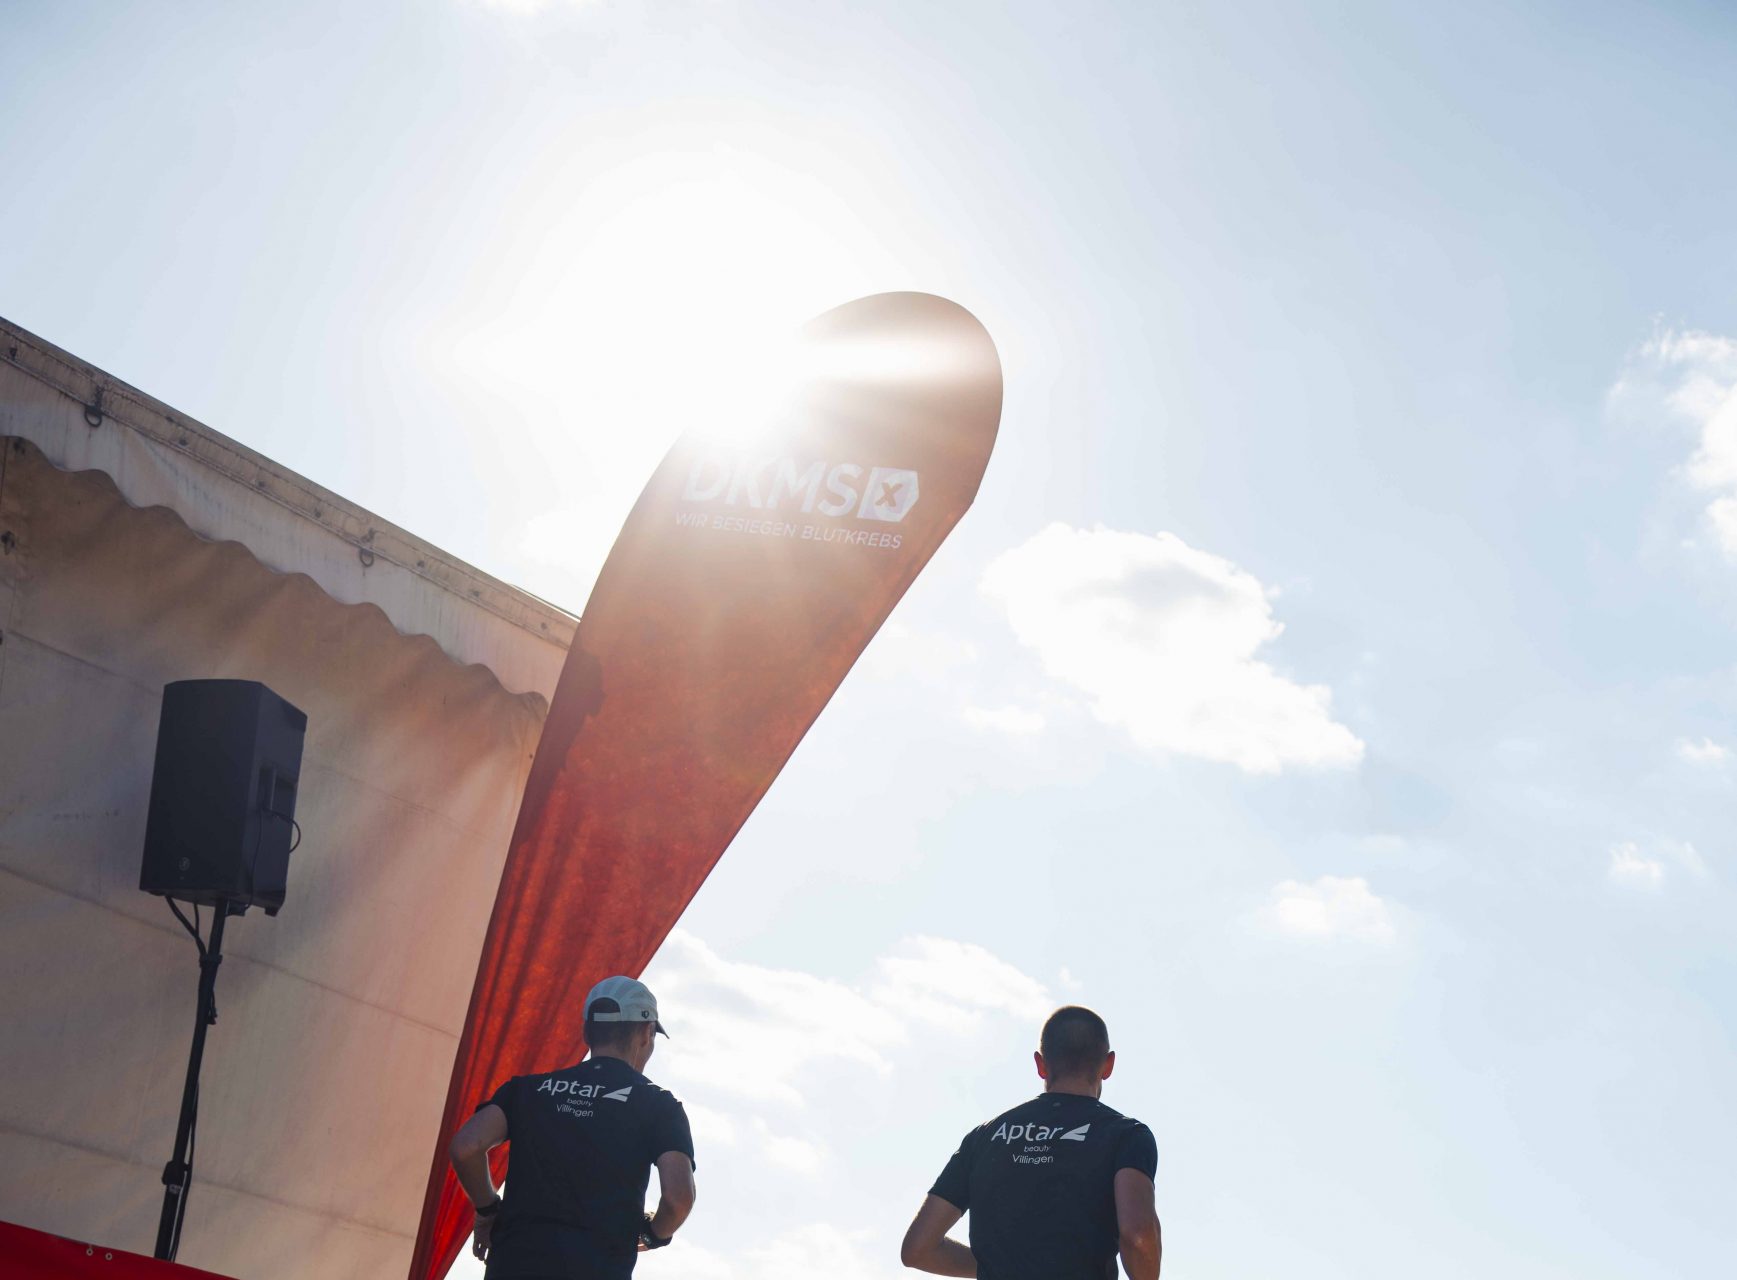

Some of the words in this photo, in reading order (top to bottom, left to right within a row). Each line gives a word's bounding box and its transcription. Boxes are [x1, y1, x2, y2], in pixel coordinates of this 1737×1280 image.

[681, 452, 864, 518] DKMS
[675, 511, 708, 528] WIR
[711, 514, 796, 538] BESIEGEN
[801, 524, 903, 550] BLUTKREBS
[537, 1077, 606, 1098] Aptar
[556, 1103, 594, 1118] Villingen
[990, 1121, 1064, 1145] Aptar
[1012, 1153, 1054, 1165] Villingen
